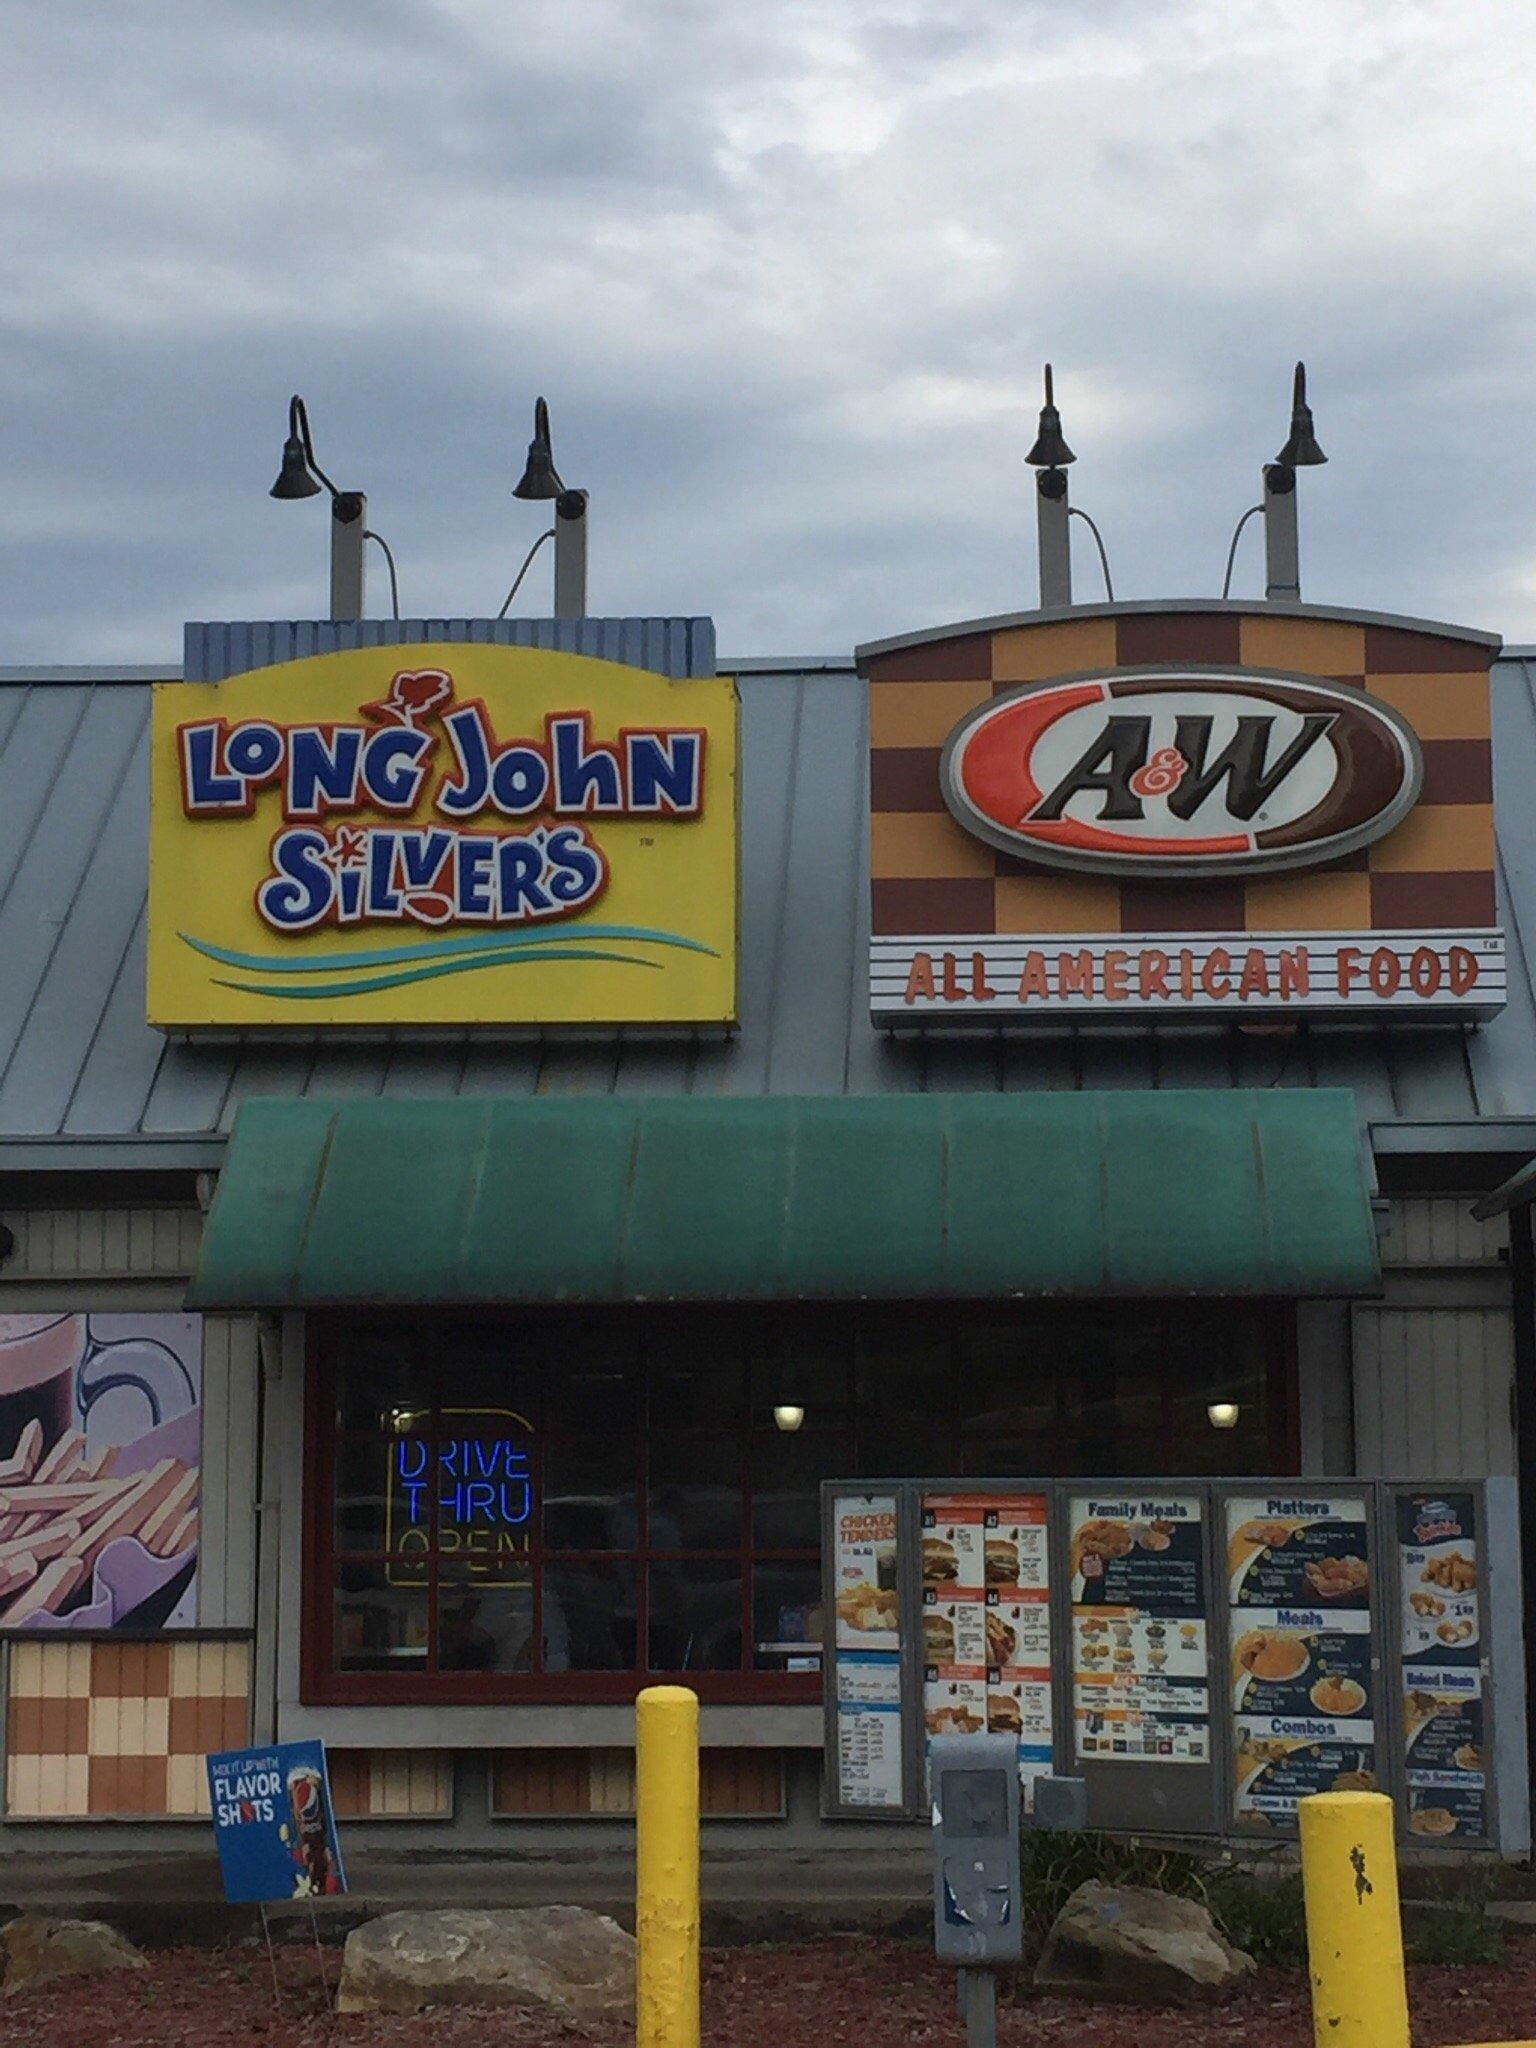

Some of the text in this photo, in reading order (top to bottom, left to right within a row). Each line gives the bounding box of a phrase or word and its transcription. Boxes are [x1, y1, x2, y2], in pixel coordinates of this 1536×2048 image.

[1020, 714, 1341, 823] A&W
[905, 945, 1479, 1005] ALL AMERICAN FOOD
[400, 1440, 530, 1479] DRIVE
[401, 1482, 531, 1524] THRU
[1088, 1502, 1187, 1519] Family Meals
[1267, 1501, 1330, 1515] Platters
[1277, 1610, 1324, 1625] Meals
[1271, 1718, 1336, 1735] Combos
[214, 1772, 282, 1801] FLAVOR
